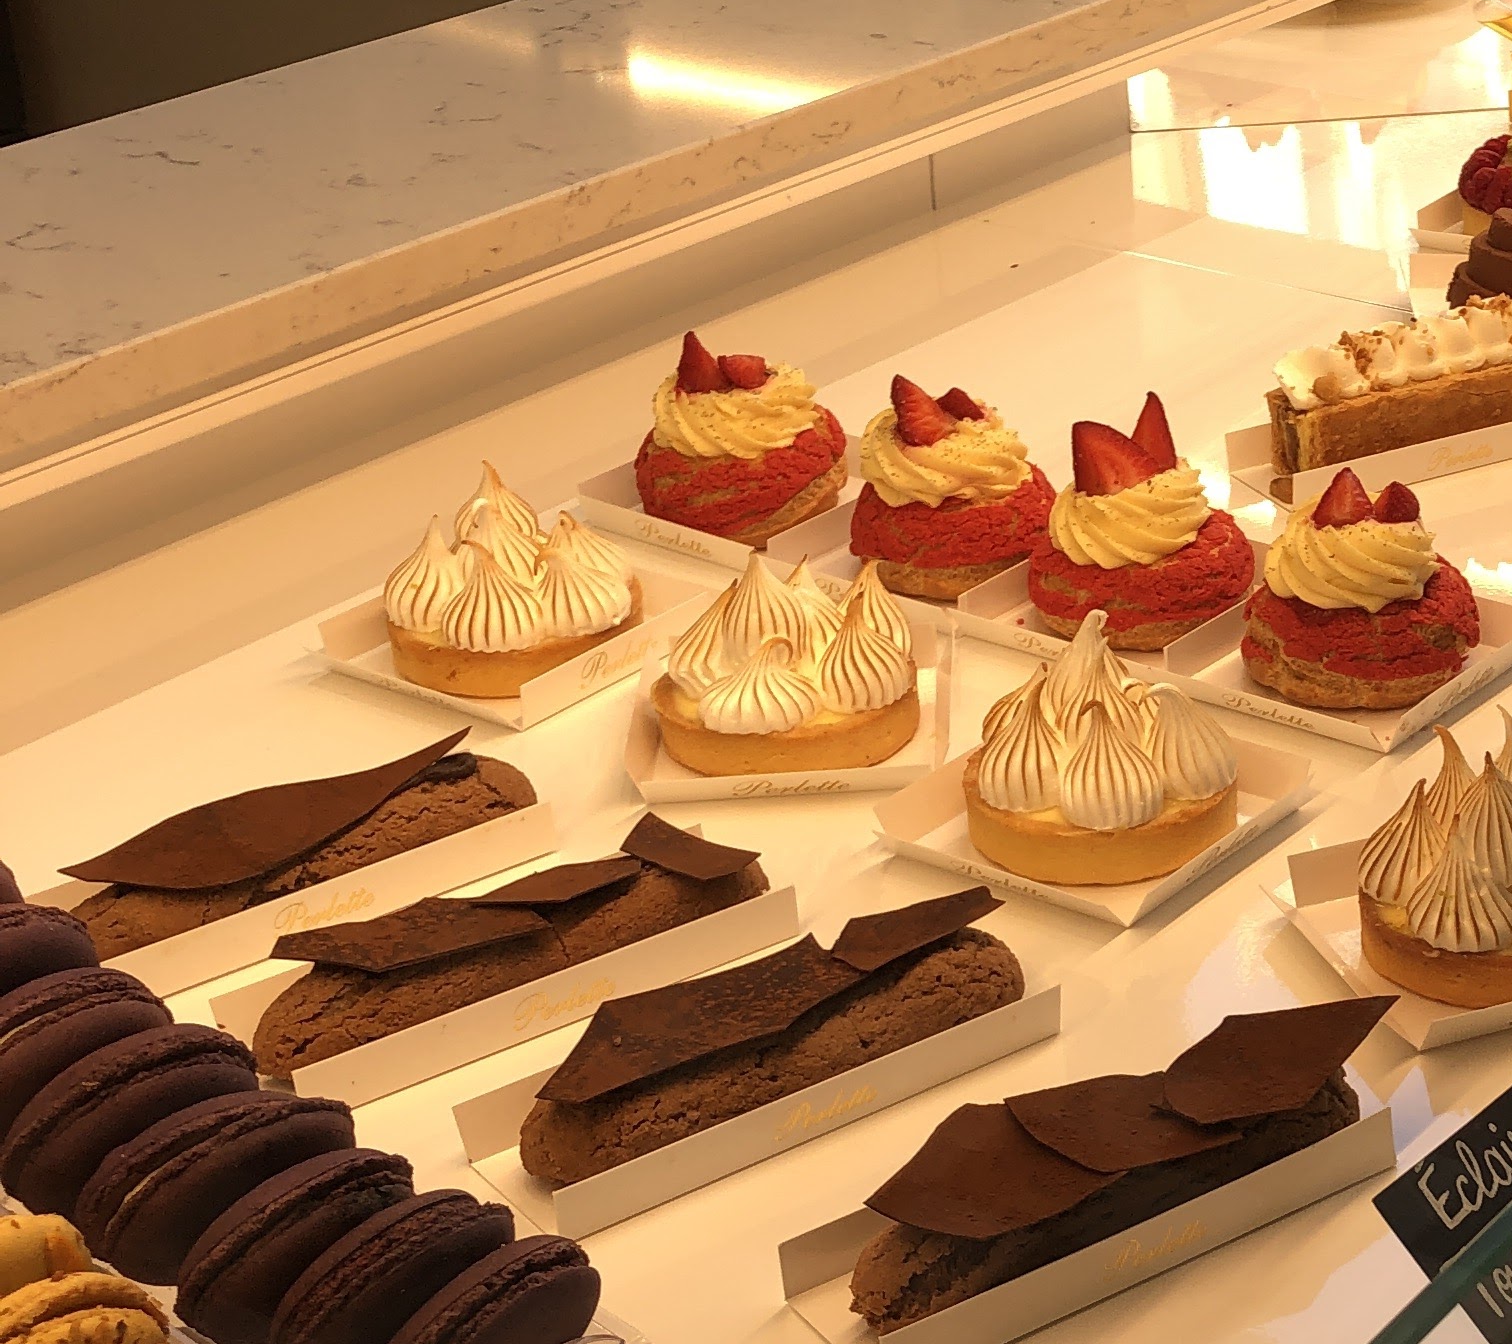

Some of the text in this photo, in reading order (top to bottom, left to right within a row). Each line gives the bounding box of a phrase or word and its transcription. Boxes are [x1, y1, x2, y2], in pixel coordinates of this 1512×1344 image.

[634, 518, 713, 557] Perlette
[1221, 692, 1317, 730] Perlette
[732, 779, 851, 797] Perlette
[273, 887, 375, 933] Perlette
